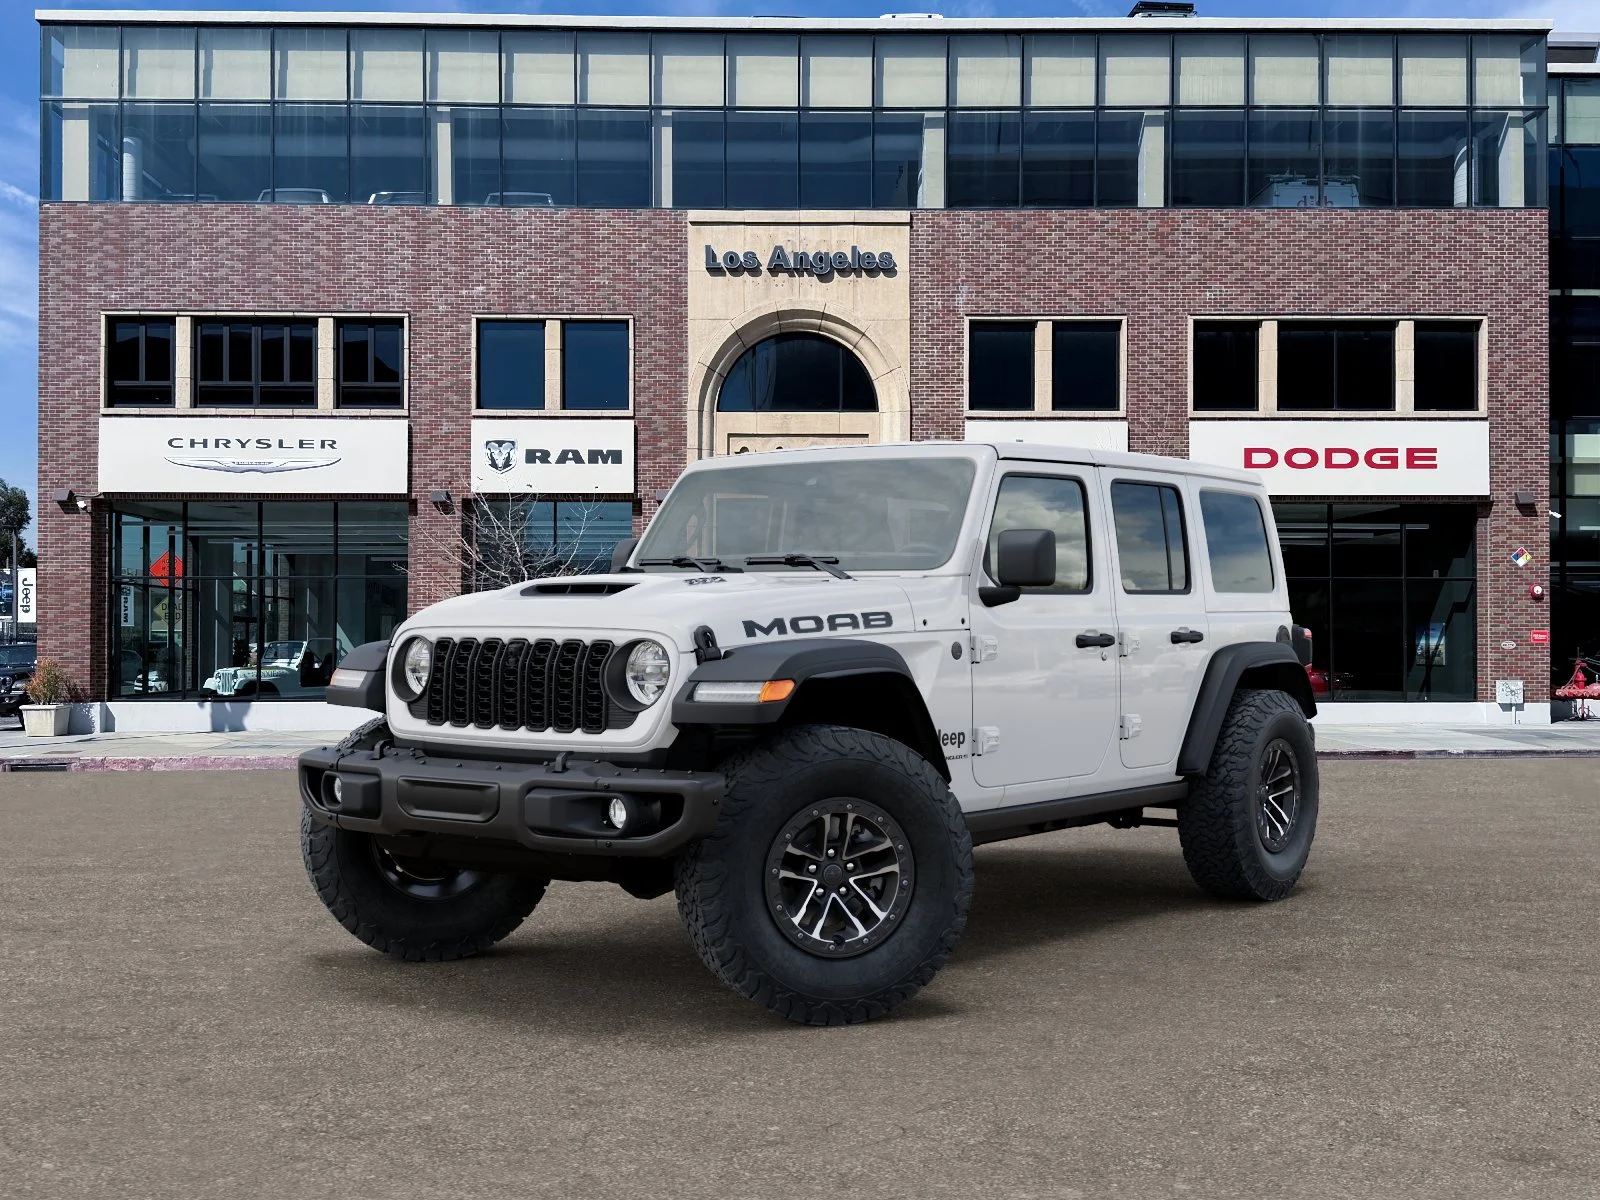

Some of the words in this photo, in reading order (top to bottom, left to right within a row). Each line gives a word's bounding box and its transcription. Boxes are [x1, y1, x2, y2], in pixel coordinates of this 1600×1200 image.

[1297, 196, 1334, 207] dih
[705, 244, 758, 269] Los
[767, 245, 894, 275] Angeles
[167, 437, 338, 449] CHRYSLER
[525, 448, 622, 464] RAM
[1243, 447, 1438, 469] DODGE
[20, 577, 33, 613] Jeep
[742, 611, 893, 638] MOAB
